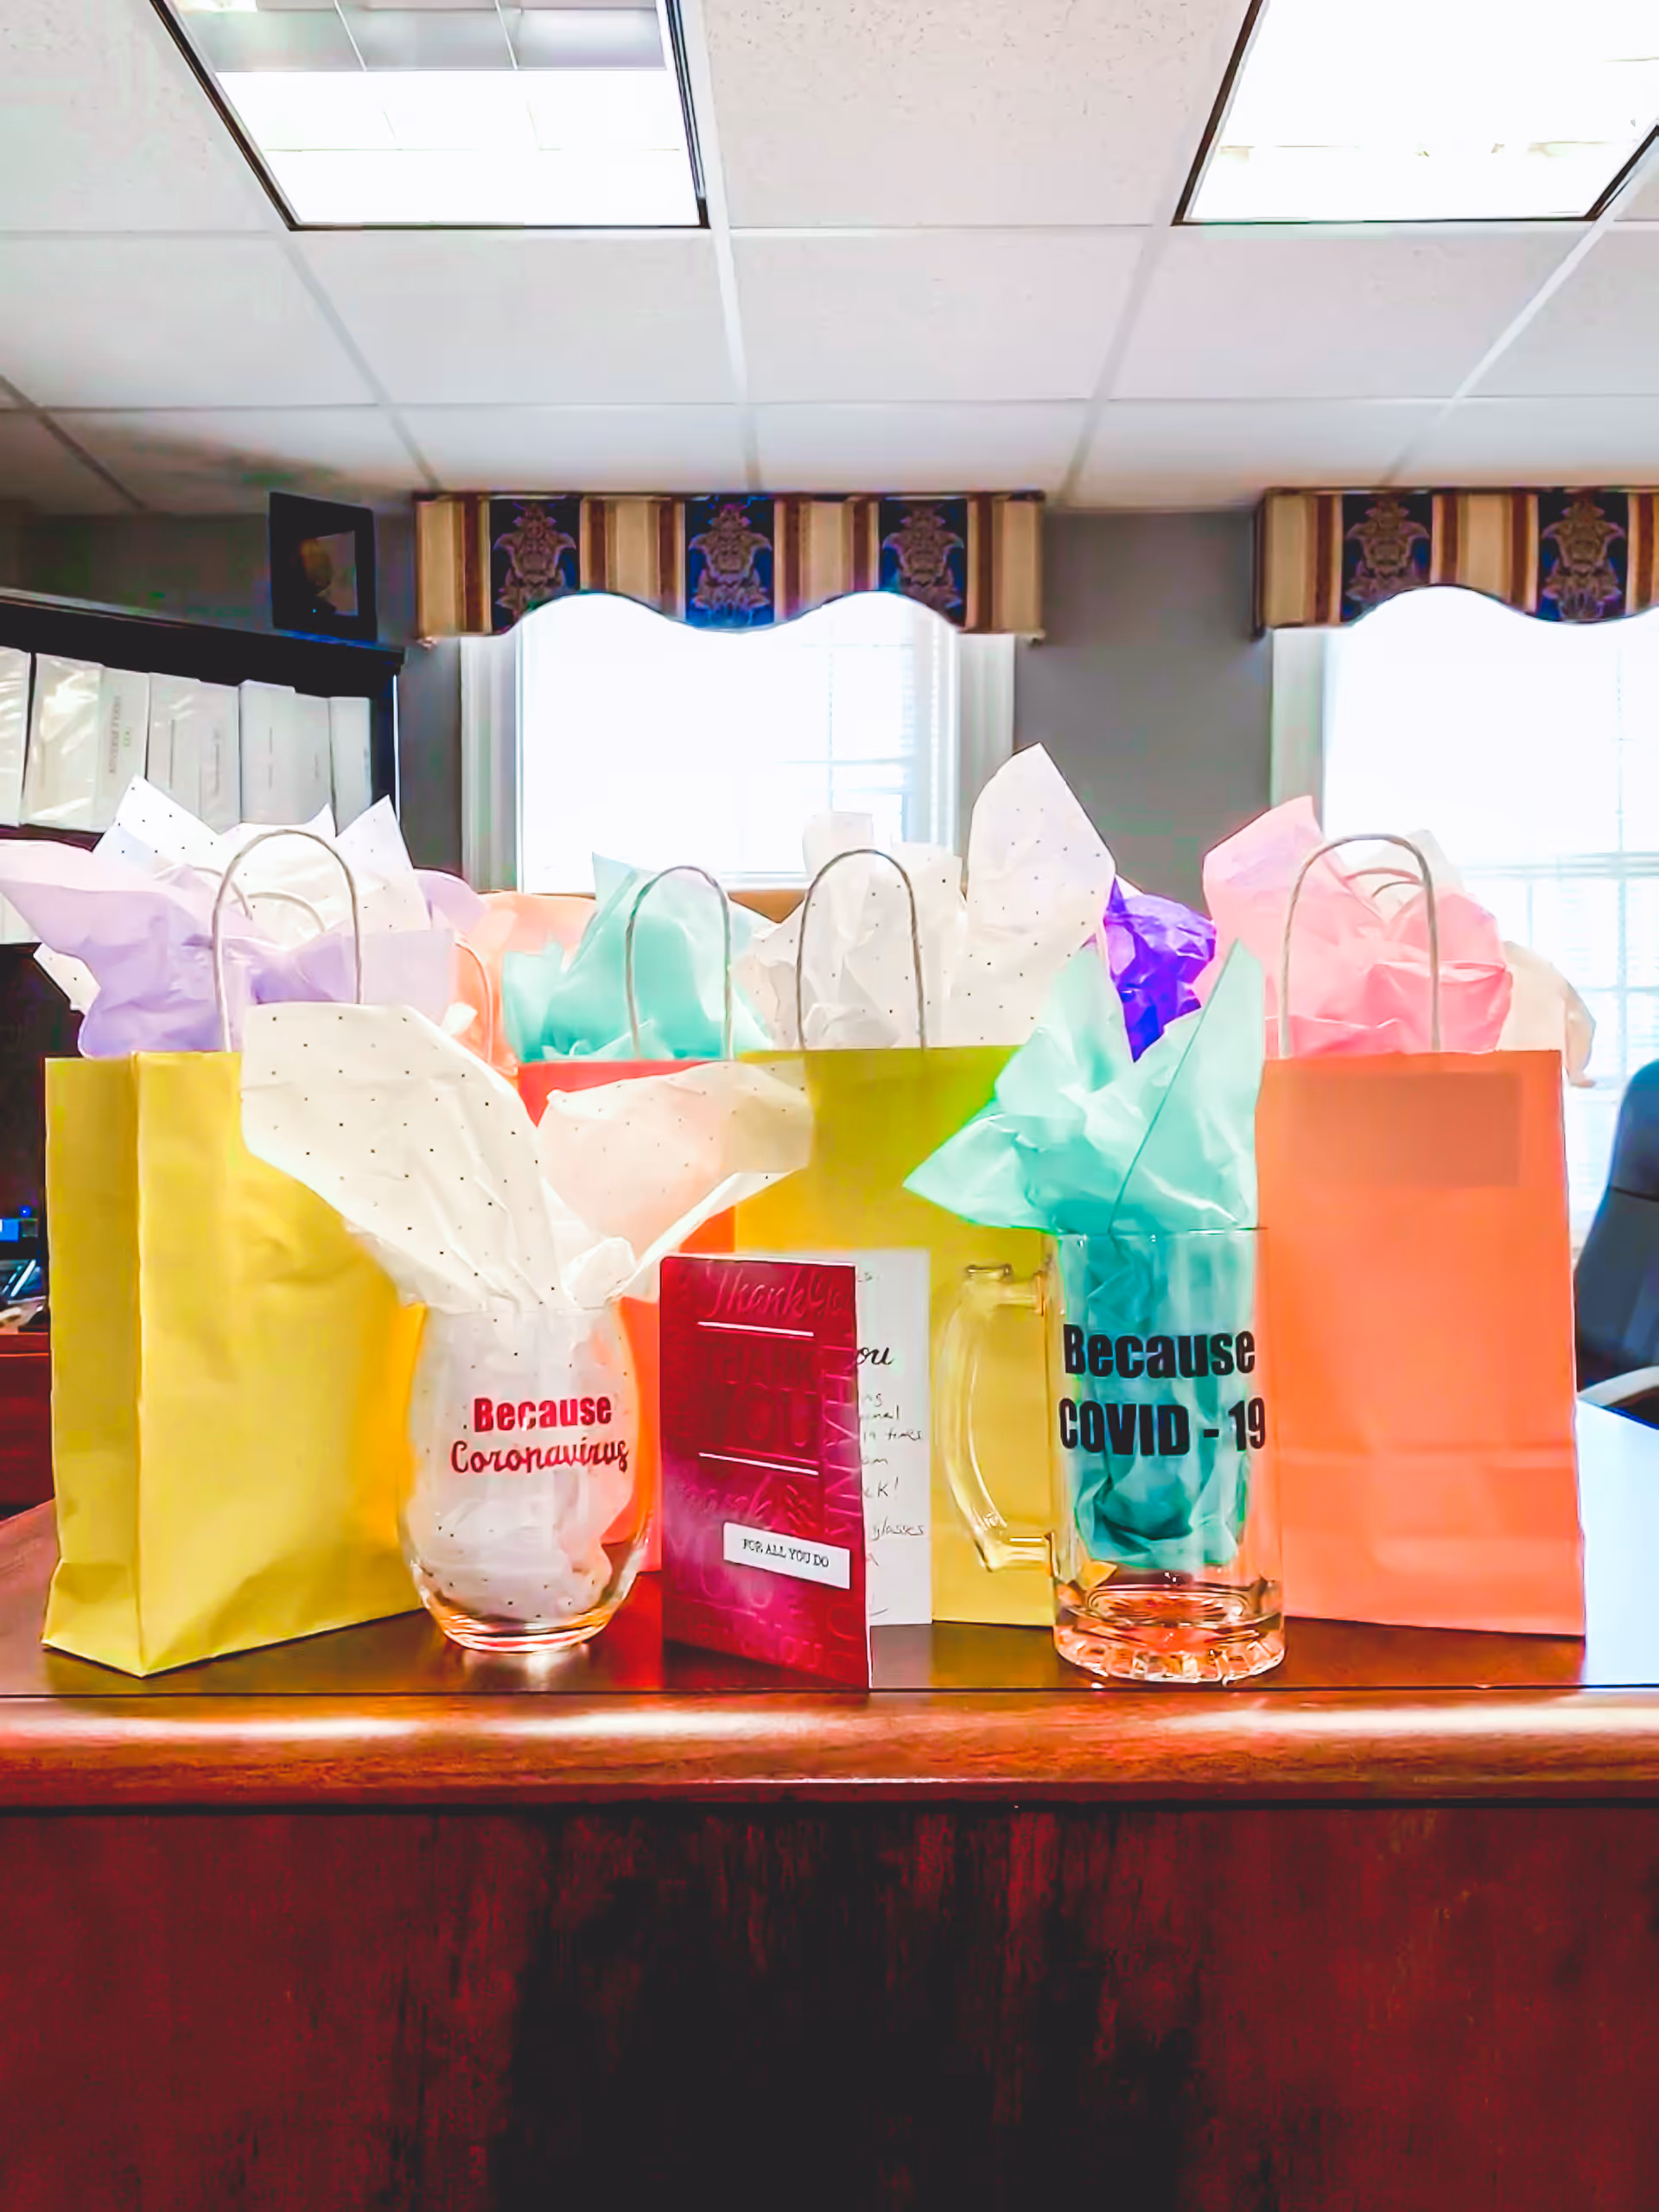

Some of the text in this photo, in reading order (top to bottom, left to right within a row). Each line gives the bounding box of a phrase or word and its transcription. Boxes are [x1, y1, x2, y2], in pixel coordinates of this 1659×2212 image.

[855, 1346, 895, 1366] ou
[1063, 1324, 1255, 1379] Because
[473, 1395, 613, 1433] Because
[1058, 1397, 1191, 1457] COVID
[1228, 1396, 1266, 1452] 19
[450, 1437, 630, 1474] Coronavirus
[765, 1543, 787, 1559] ALL
[788, 1548, 811, 1565] YOU
[813, 1554, 830, 1568] DO
